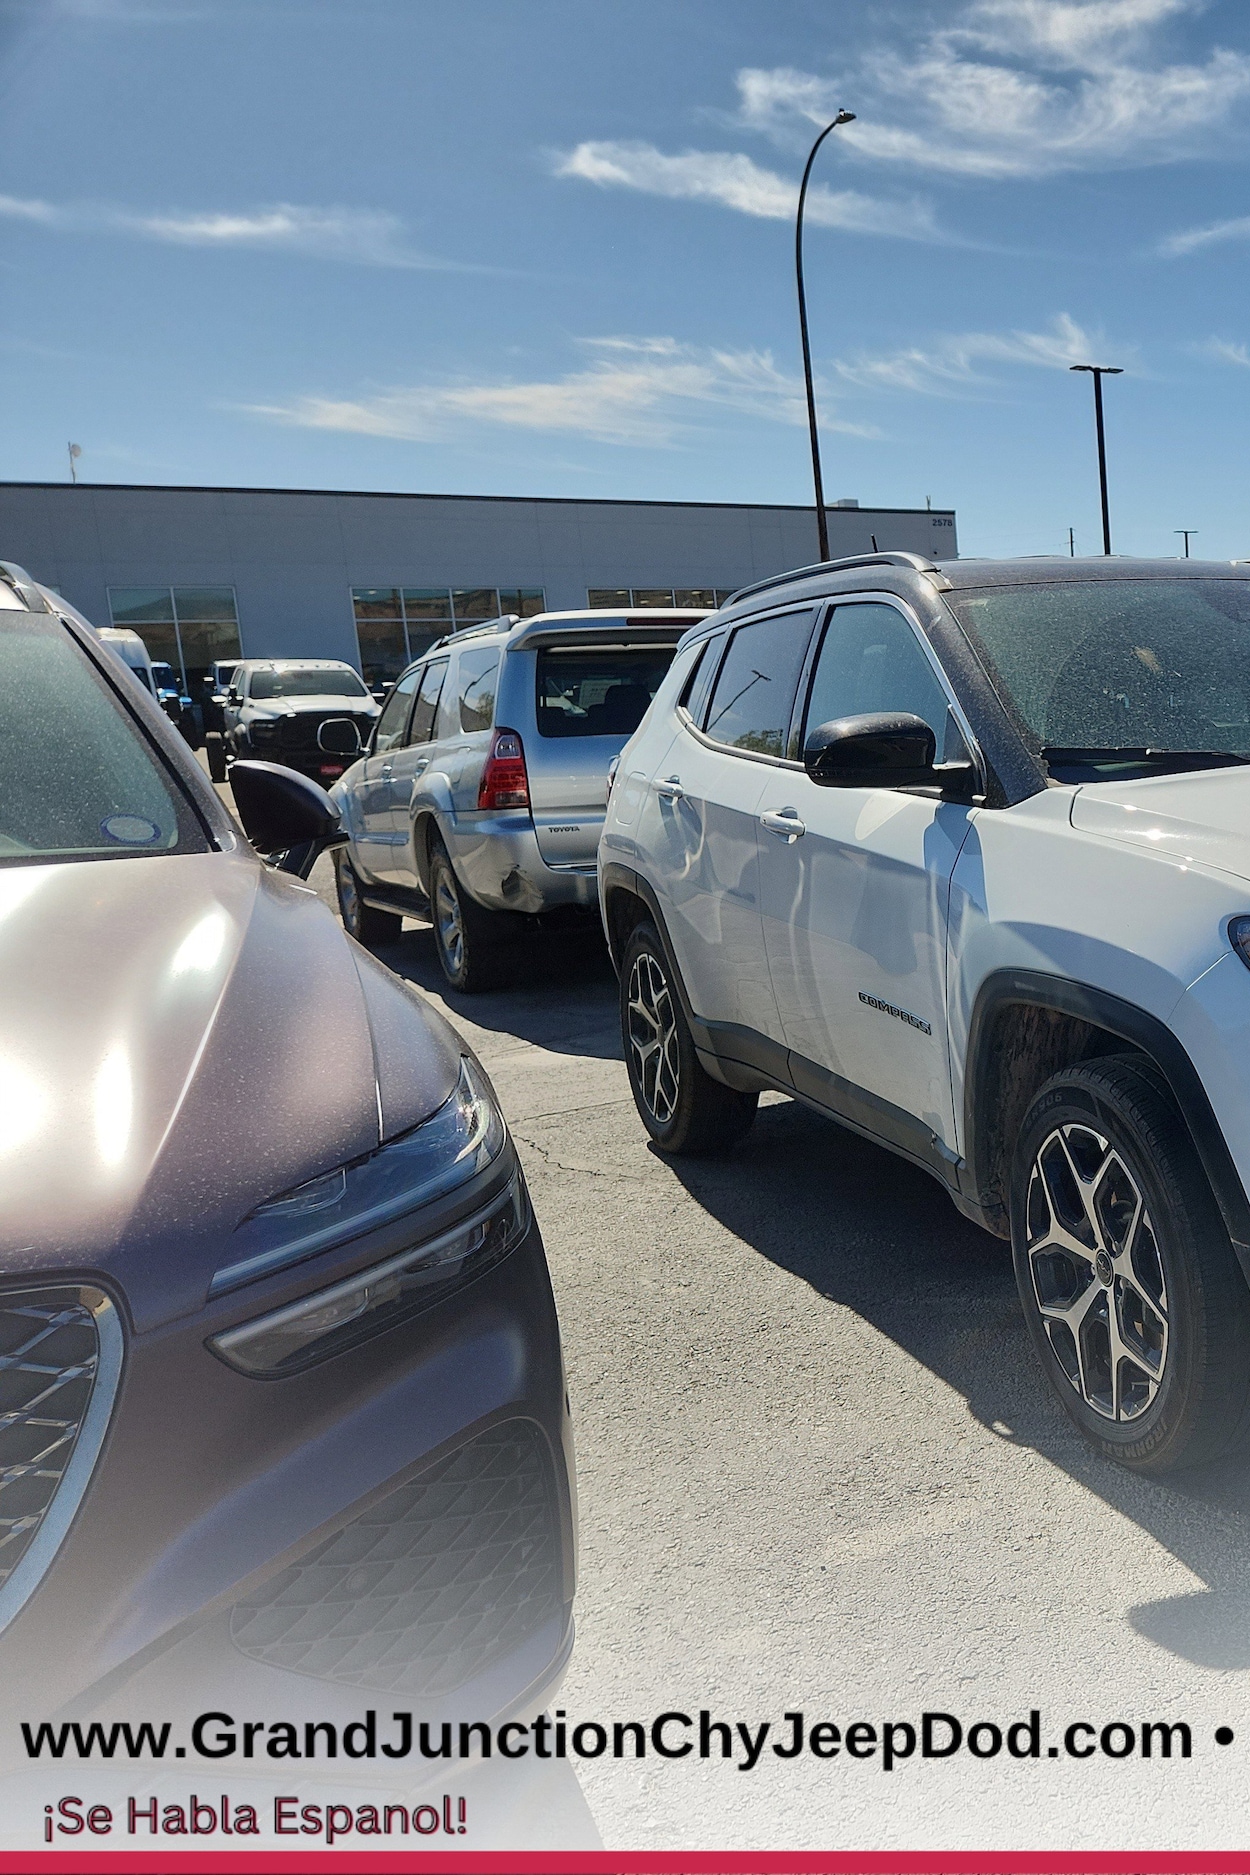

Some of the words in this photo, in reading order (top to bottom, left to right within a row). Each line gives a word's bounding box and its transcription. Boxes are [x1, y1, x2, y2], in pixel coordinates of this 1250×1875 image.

[932, 518, 953, 527] 2578
[548, 826, 580, 834] TOYOTA
[857, 990, 932, 1036] COMPASS
